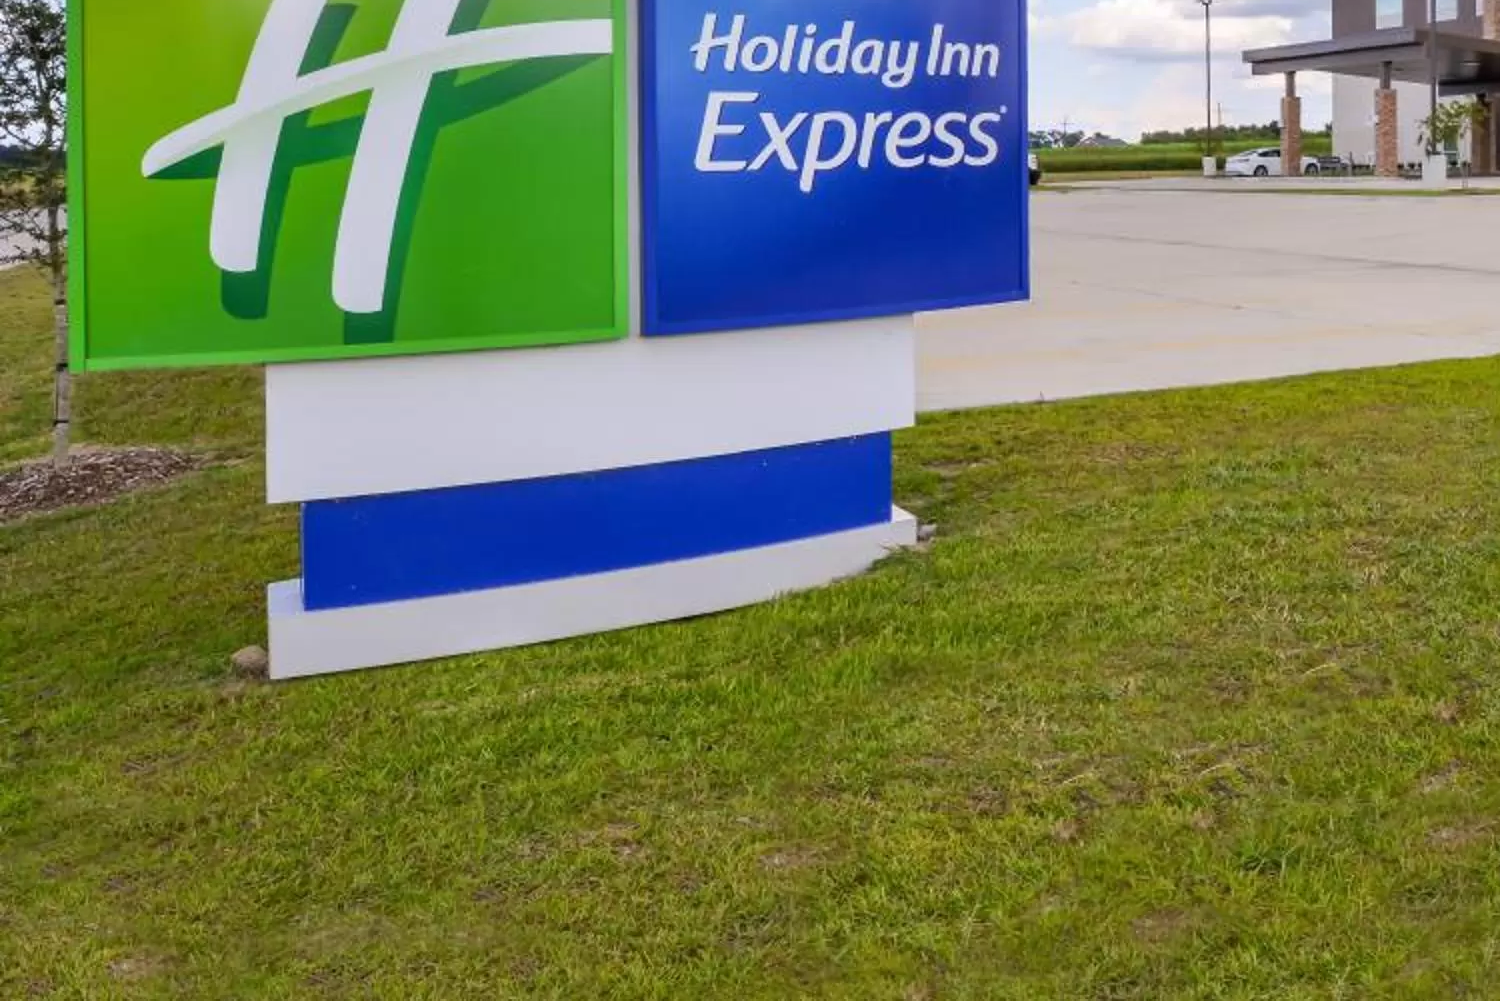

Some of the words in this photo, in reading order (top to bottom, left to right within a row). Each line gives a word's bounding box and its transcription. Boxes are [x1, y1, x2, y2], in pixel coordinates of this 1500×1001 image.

[690, 12, 920, 88] Holiday
[926, 23, 1000, 78] Inn
[694, 91, 1002, 193] Express
